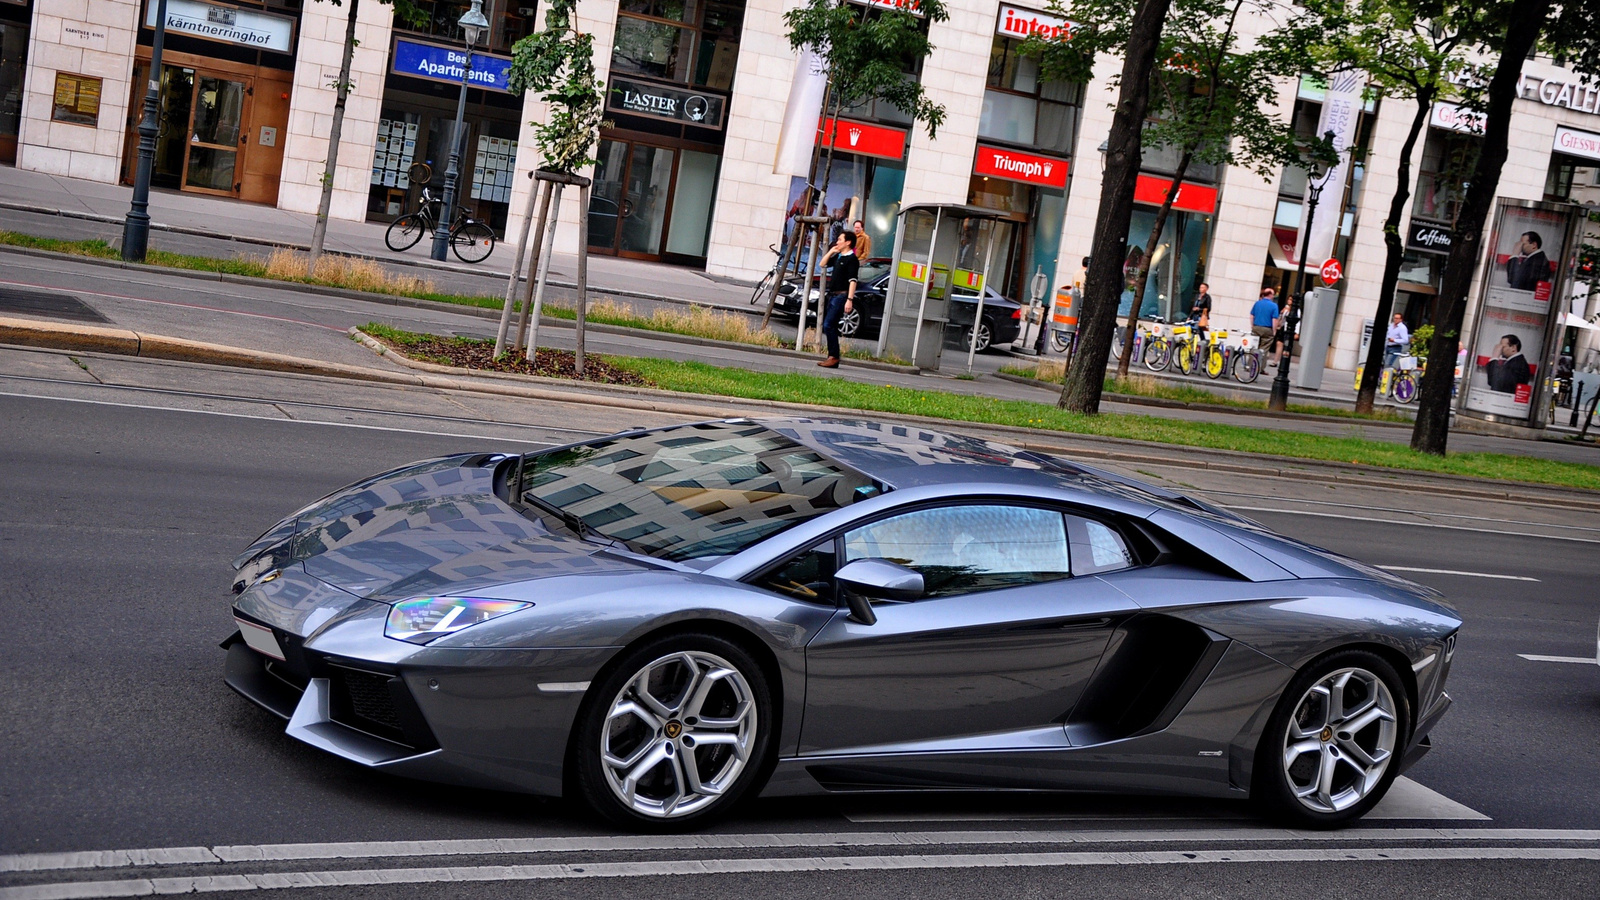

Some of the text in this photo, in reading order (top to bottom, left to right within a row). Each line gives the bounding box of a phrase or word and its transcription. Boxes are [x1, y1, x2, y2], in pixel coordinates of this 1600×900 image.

[167, 16, 271, 44] kärntnerringhof
[447, 51, 467, 64] Bes
[418, 58, 495, 83] Apartments
[623, 90, 676, 111] LASTER
[993, 154, 1042, 178] Triumph
